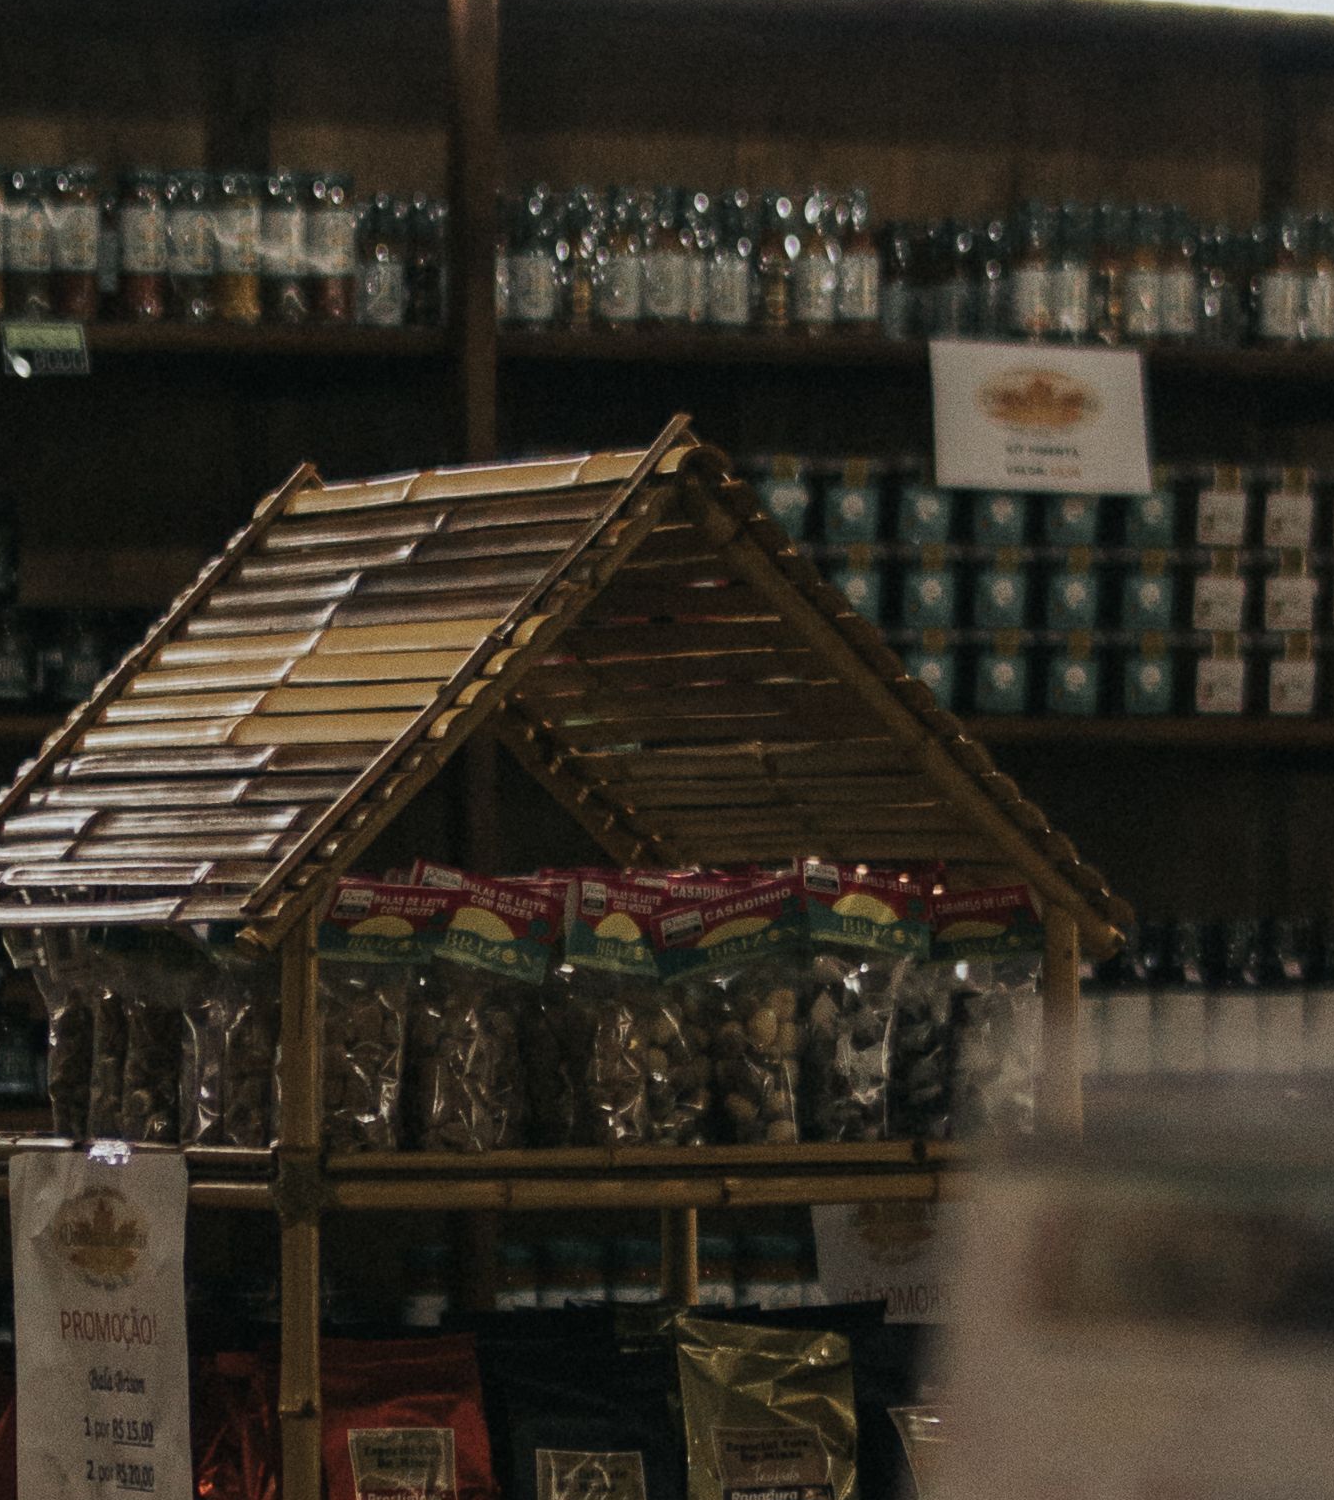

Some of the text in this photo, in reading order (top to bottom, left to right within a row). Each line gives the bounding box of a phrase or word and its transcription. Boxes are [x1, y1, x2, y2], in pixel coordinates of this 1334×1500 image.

[464, 882, 549, 914] BALAS DE LEITE
[670, 884, 742, 901] CASADINH
[704, 887, 792, 922] CASADINHO
[470, 894, 534, 920] COM NOZES
[60, 1307, 157, 1351] PROMOÇÃO!
[84, 1416, 92, 1437] 1
[94, 1419, 110, 1442] por
[86, 1459, 94, 1481] 2
[98, 1464, 114, 1483] por
